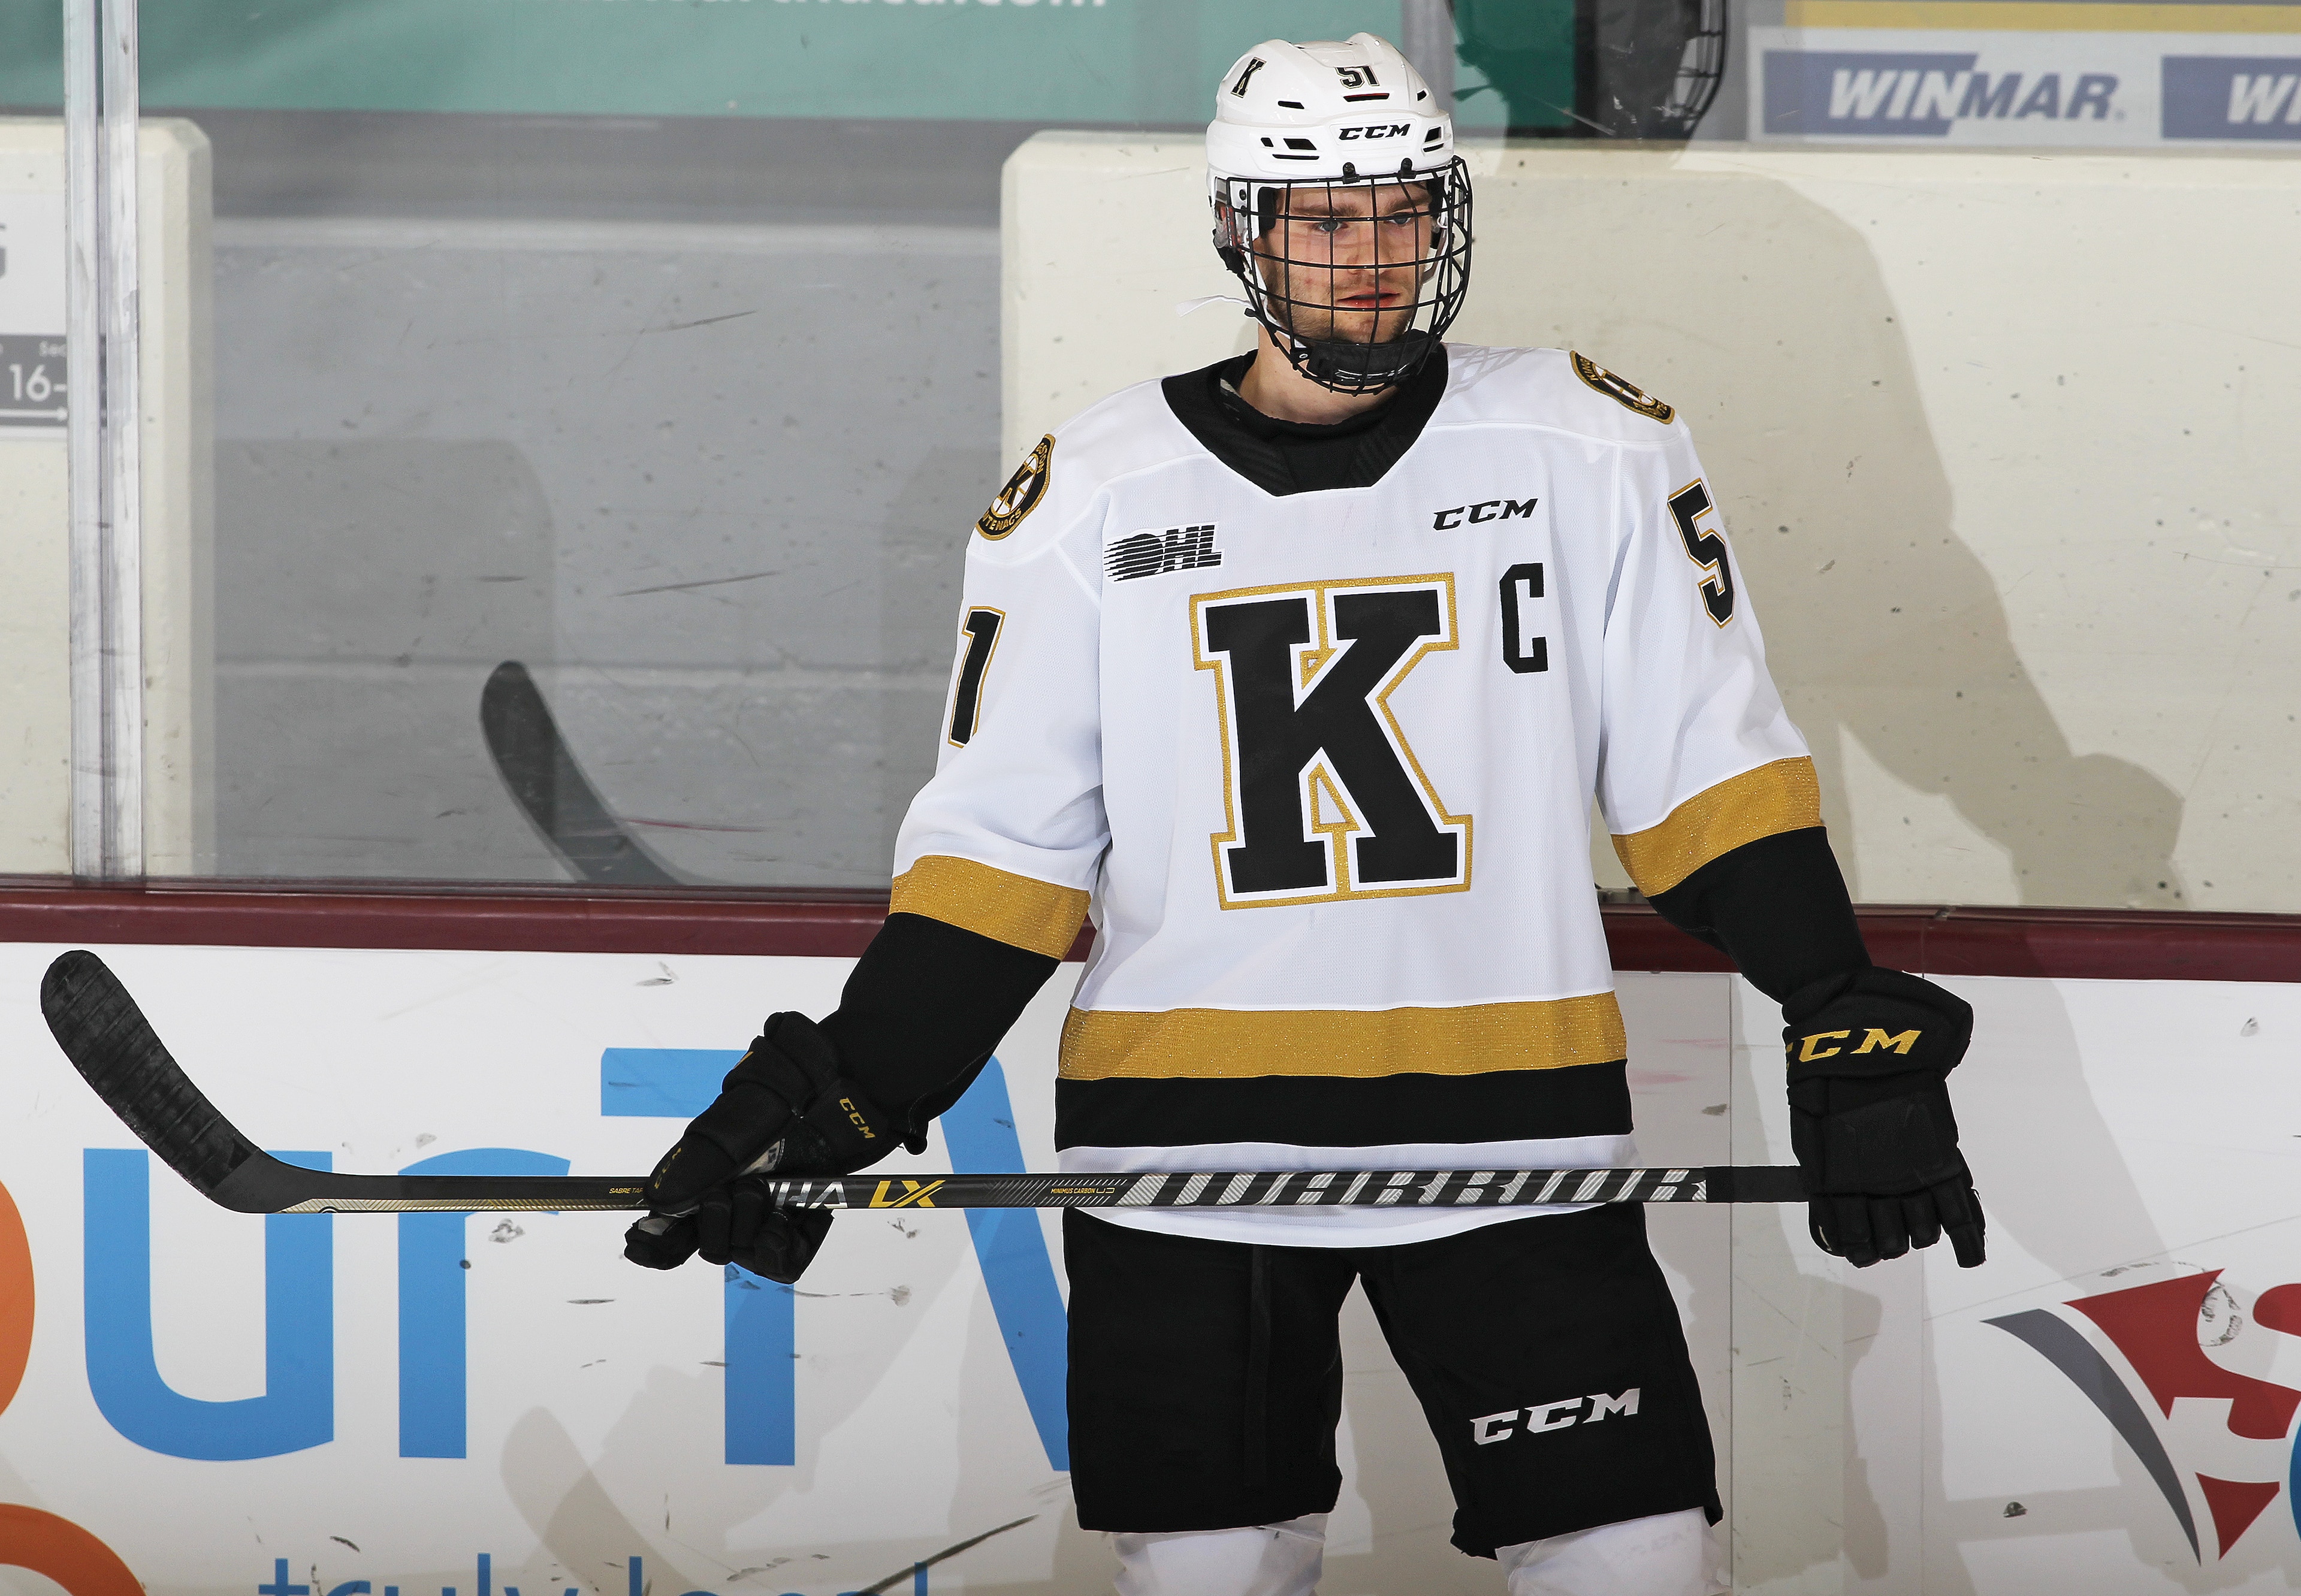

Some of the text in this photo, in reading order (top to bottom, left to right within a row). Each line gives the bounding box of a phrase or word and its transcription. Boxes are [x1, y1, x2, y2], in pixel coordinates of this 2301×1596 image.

[1231, 56, 1266, 98] K
[1335, 65, 1379, 89] 51
[1828, 69, 2119, 120] WINMAR
[1338, 123, 1411, 141] CCM
[1433, 498, 1538, 531] CCM
[1104, 525, 1222, 582] OHL
[1667, 477, 1735, 629] 5
[1499, 563, 1548, 674] C
[947, 606, 1006, 749] 1
[1189, 572, 1473, 911] K
[840, 1097, 875, 1138] CCM
[869, 1180, 946, 1208] LX
[1469, 1388, 1641, 1446] CCM
